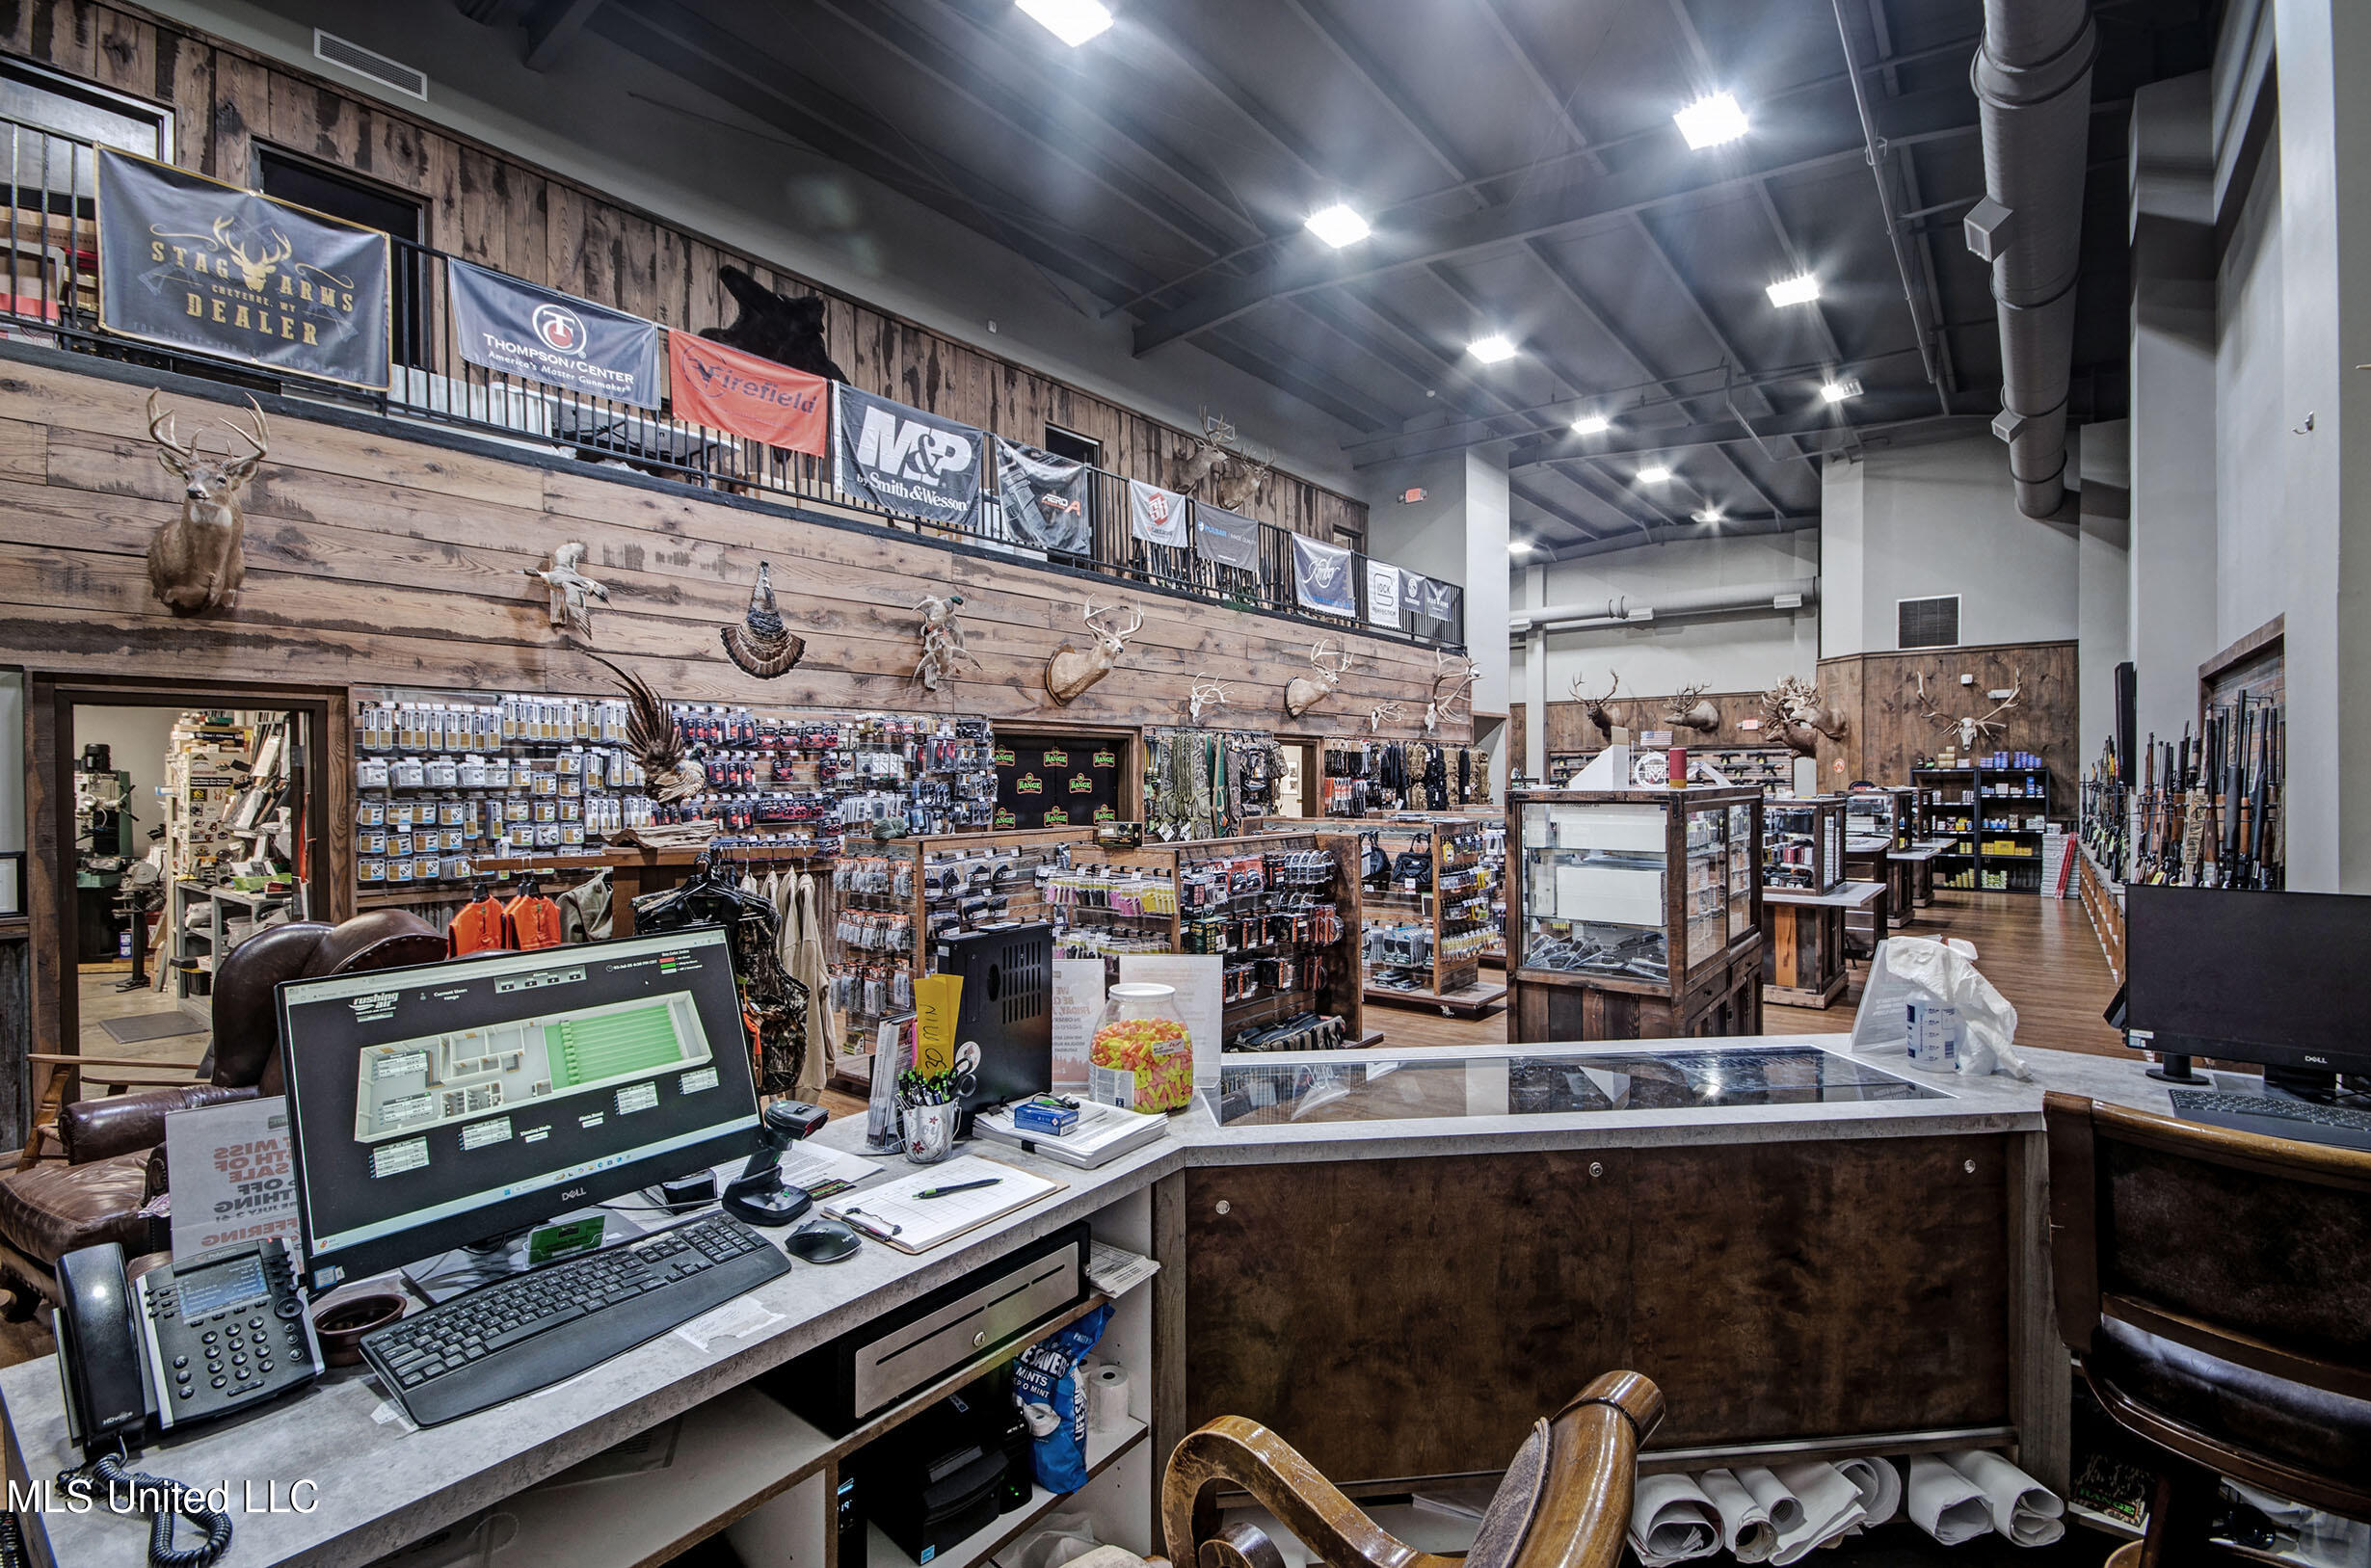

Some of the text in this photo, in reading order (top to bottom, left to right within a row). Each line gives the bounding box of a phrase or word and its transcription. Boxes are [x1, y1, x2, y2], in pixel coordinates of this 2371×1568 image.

[151, 241, 354, 312] STAG ARMS
[280, 302, 296, 313] WY
[186, 292, 319, 346] DEALER
[488, 351, 538, 371] America's
[541, 364, 575, 381] Master
[708, 364, 817, 414] Firefield
[857, 405, 972, 488] M&P
[856, 473, 868, 488] by
[1042, 493, 1069, 507] AERO
[1046, 754, 1067, 762] RANGE
[1019, 781, 1041, 789] RANGE
[1071, 781, 1091, 789] RANGE
[1046, 814, 1067, 823] RANGE
[353, 992, 399, 1005] rushing
[375, 999, 391, 1009] air
[918, 1003, 947, 1070] 30 MIN
[2304, 1055, 2329, 1064] DELL
[561, 1187, 587, 1202] DELL
[1016, 1367, 1049, 1387] MINTS
[1029, 1385, 1050, 1398] MINT
